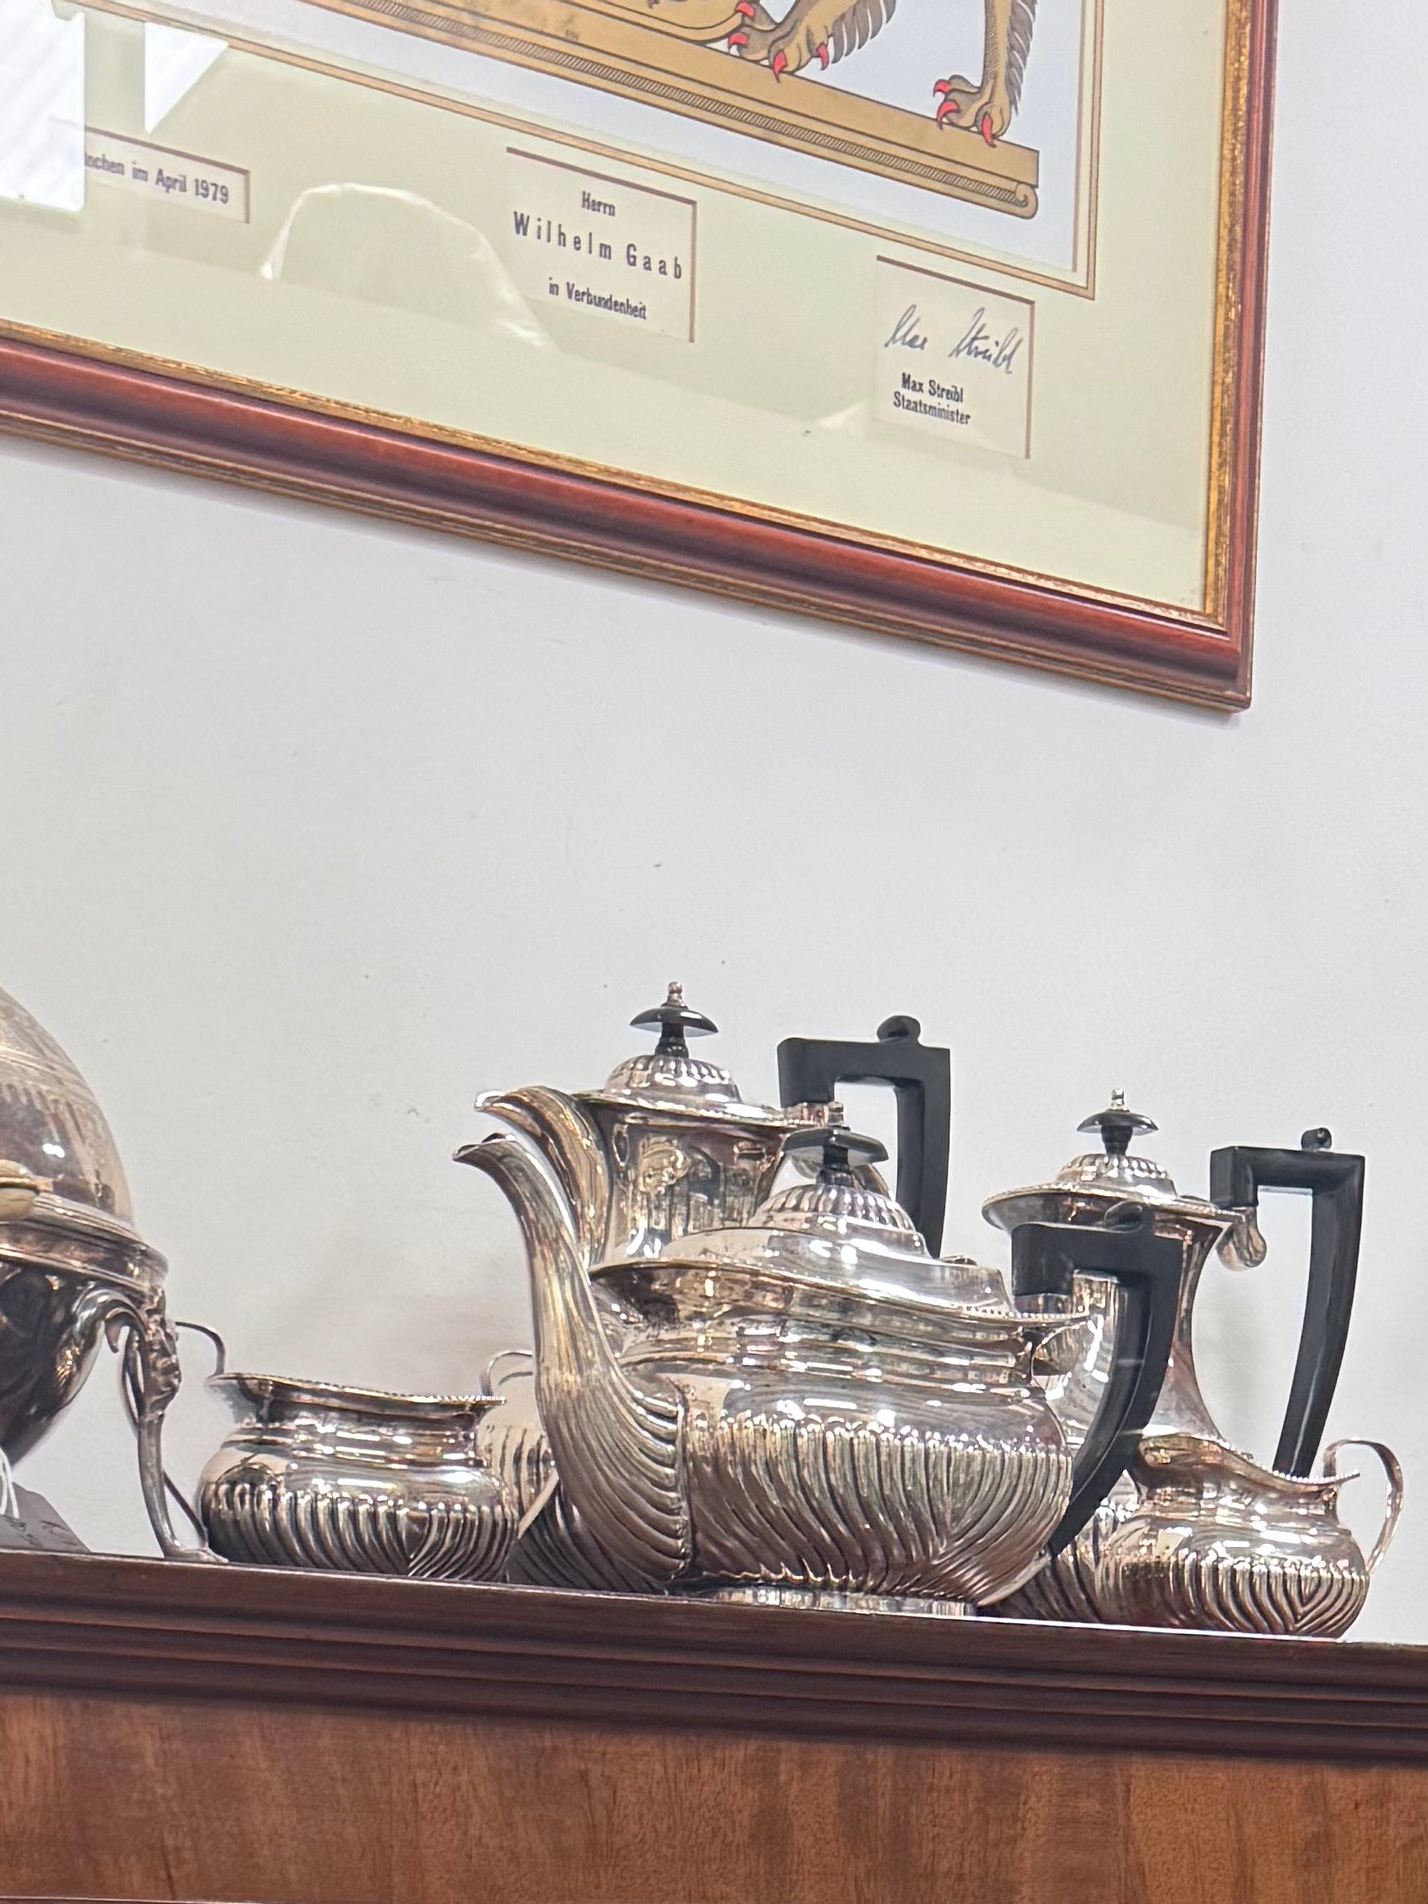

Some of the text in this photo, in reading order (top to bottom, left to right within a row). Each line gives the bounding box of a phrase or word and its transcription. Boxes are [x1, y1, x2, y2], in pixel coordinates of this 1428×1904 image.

[84, 151, 230, 205] nchen im April 1979
[581, 190, 616, 217] Herrn
[513, 210, 682, 280] Wilhelm Gaab
[548, 276, 647, 320] in Verbundenheit
[901, 372, 964, 403] Max Streibl
[893, 391, 971, 425] Staatsminister
